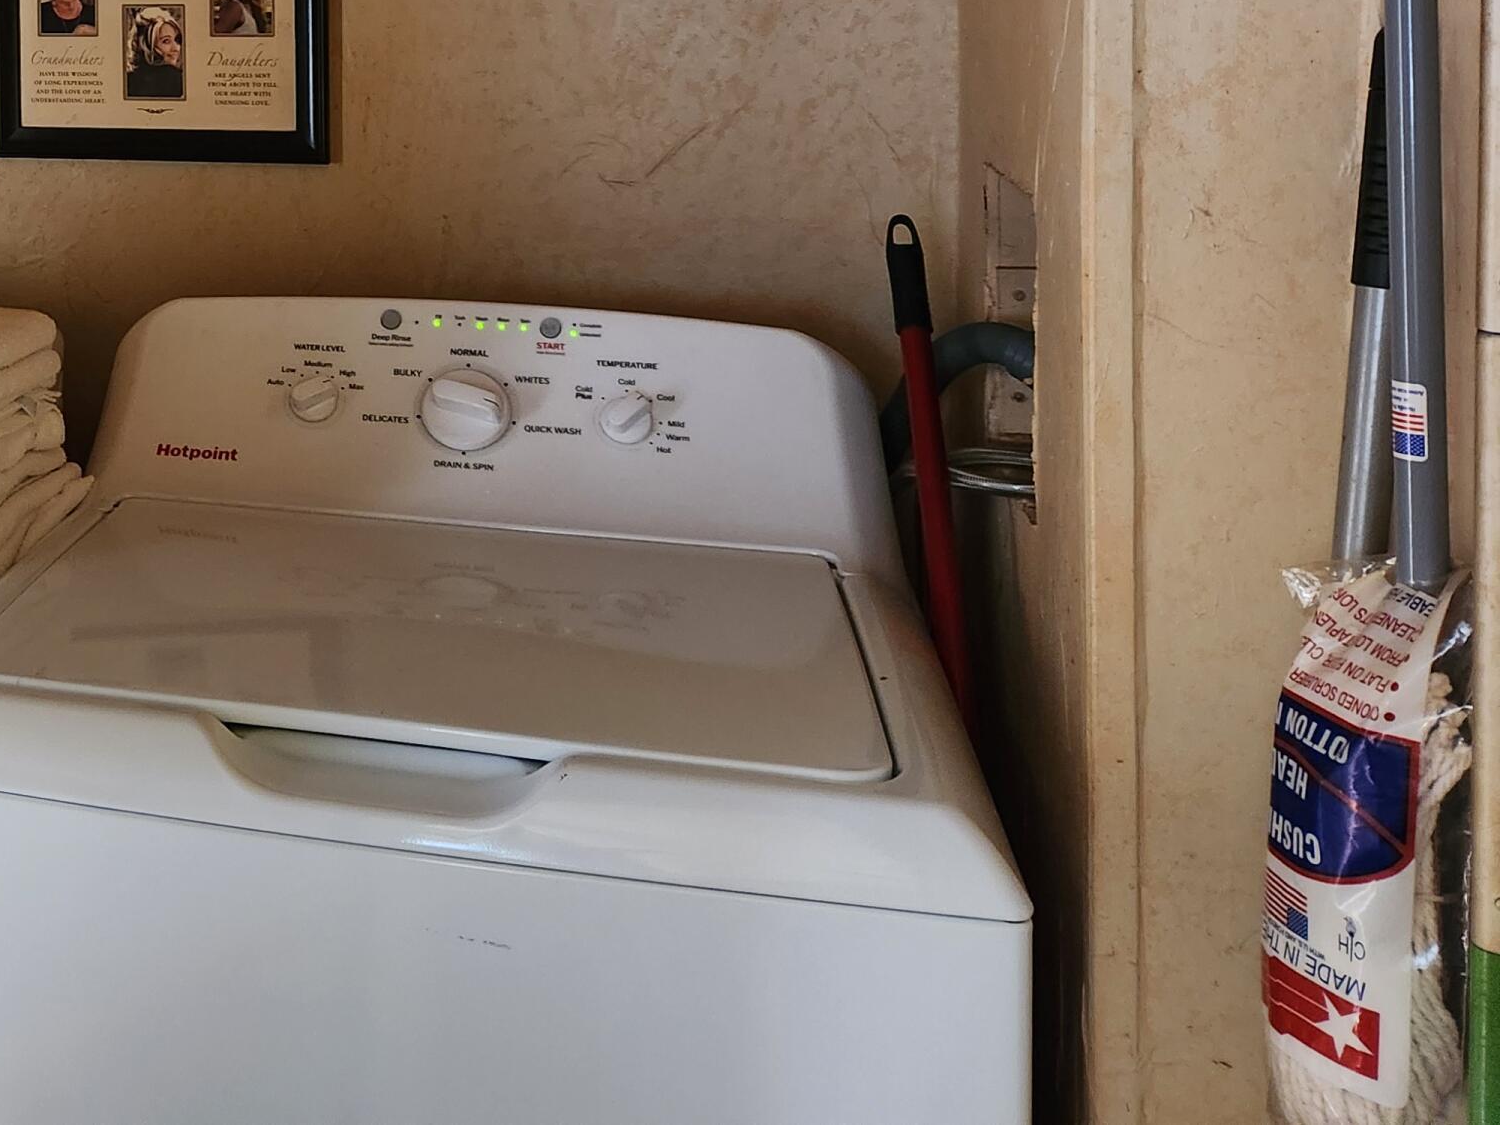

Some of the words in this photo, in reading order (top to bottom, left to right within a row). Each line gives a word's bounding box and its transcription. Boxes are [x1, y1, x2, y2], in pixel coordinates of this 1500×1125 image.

[31, 46, 105, 66] Grandmothers
[207, 44, 279, 74] Daughters
[371, 333, 390, 342] Deep
[391, 334, 412, 342] Rinse
[293, 343, 320, 351] WATER
[321, 344, 346, 353] LEVEL
[536, 342, 565, 350] START
[450, 348, 489, 357] NORMAL
[304, 360, 333, 368] Medium
[596, 359, 658, 370] TEMPERATURE
[339, 369, 356, 377] High
[393, 368, 423, 377] BULKY
[515, 375, 551, 385] WHITES
[617, 378, 636, 386] Cold
[575, 385, 593, 393] Cold
[575, 392, 593, 400] Plus
[362, 413, 409, 424] DELICATES
[667, 420, 685, 428] Mild
[524, 425, 553, 434] QUICK
[554, 426, 582, 436] WASH
[665, 433, 690, 442] Warm
[156, 443, 238, 461] Hotpoint
[656, 446, 672, 454] Hot
[434, 460, 462, 469] DRAIN
[463, 462, 470, 470] &
[472, 462, 494, 471] SPIN
[1360, 670, 1390, 693] FLAT
[1283, 941, 1300, 967] IN
[1304, 954, 1367, 1001] MADE
